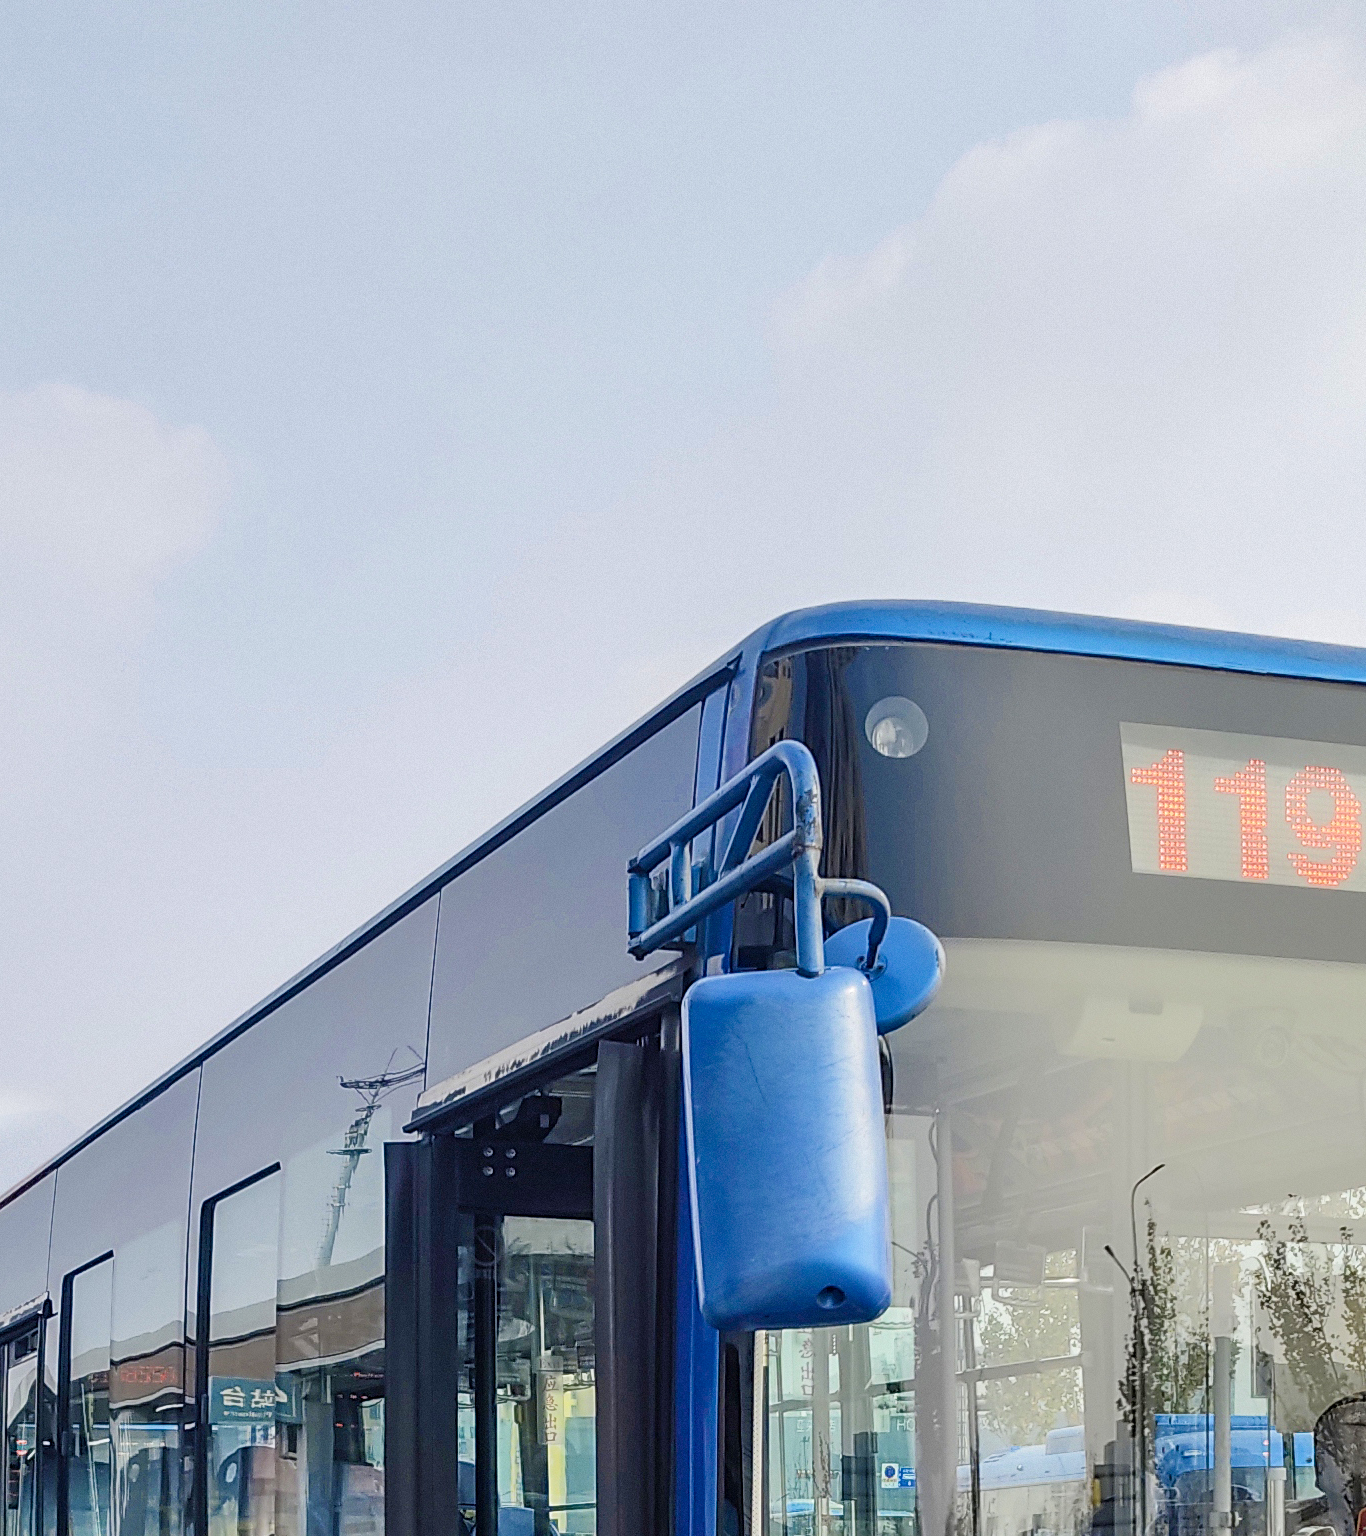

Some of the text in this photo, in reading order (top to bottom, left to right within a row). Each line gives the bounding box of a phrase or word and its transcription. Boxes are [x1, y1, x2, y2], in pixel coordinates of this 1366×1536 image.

[1130, 748, 1362, 886] 119
[543, 1374, 560, 1442] 应急出口
